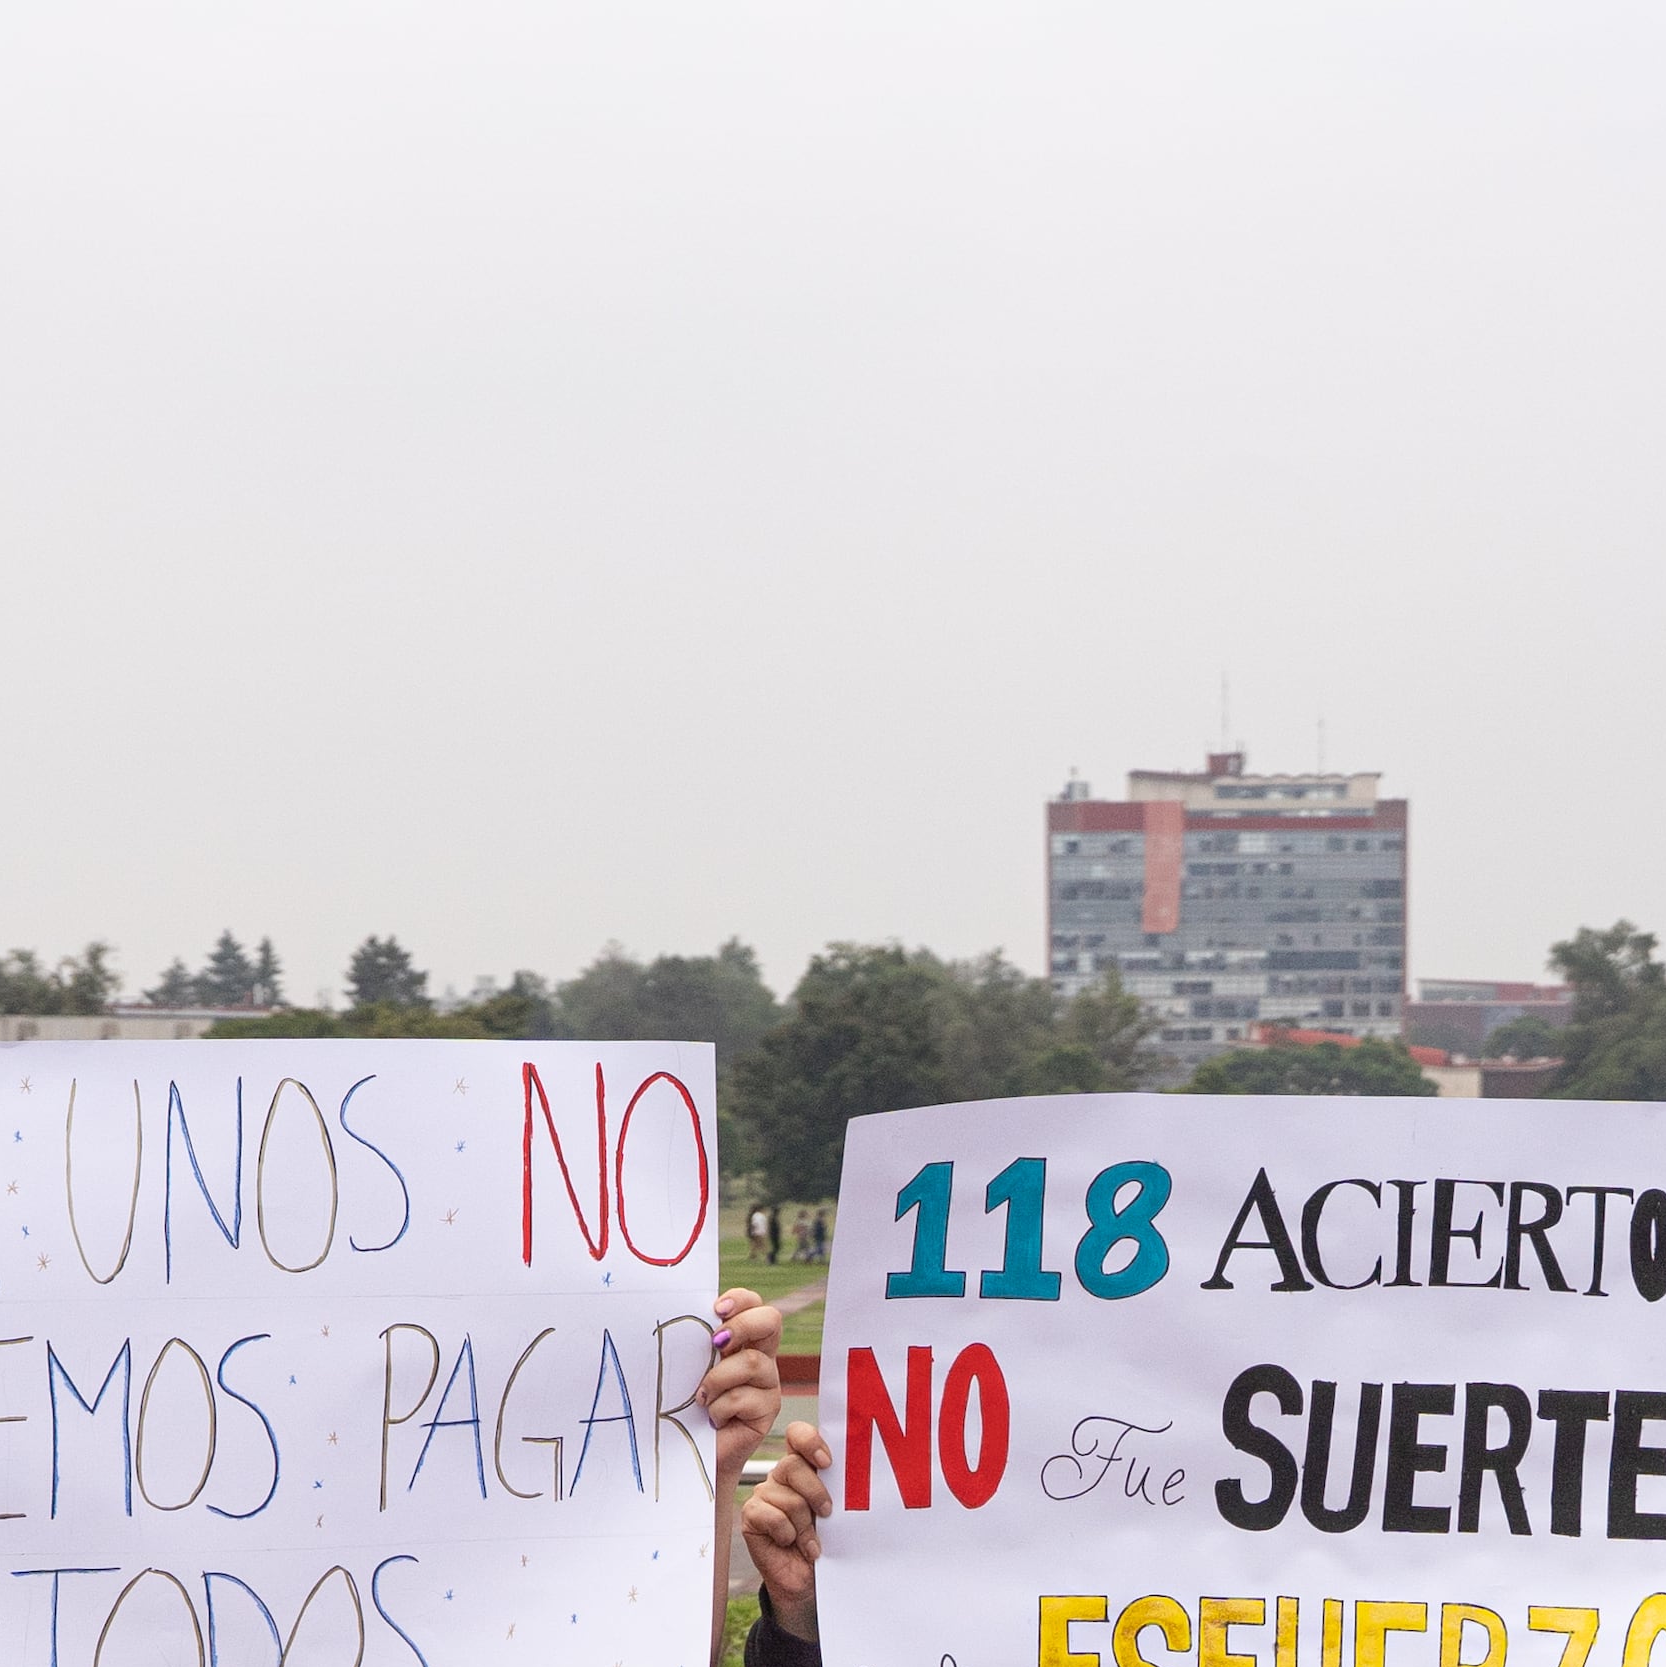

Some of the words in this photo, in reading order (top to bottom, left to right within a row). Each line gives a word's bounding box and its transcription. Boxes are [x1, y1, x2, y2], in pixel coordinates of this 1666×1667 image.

[64, 1074, 411, 1285] UNOS
[521, 1061, 709, 1269] NO
[884, 1156, 1172, 1301] 118
[379, 1314, 718, 1512] PAGAR
[844, 1341, 1011, 1512] NO
[1039, 1415, 1188, 1508] Fue
